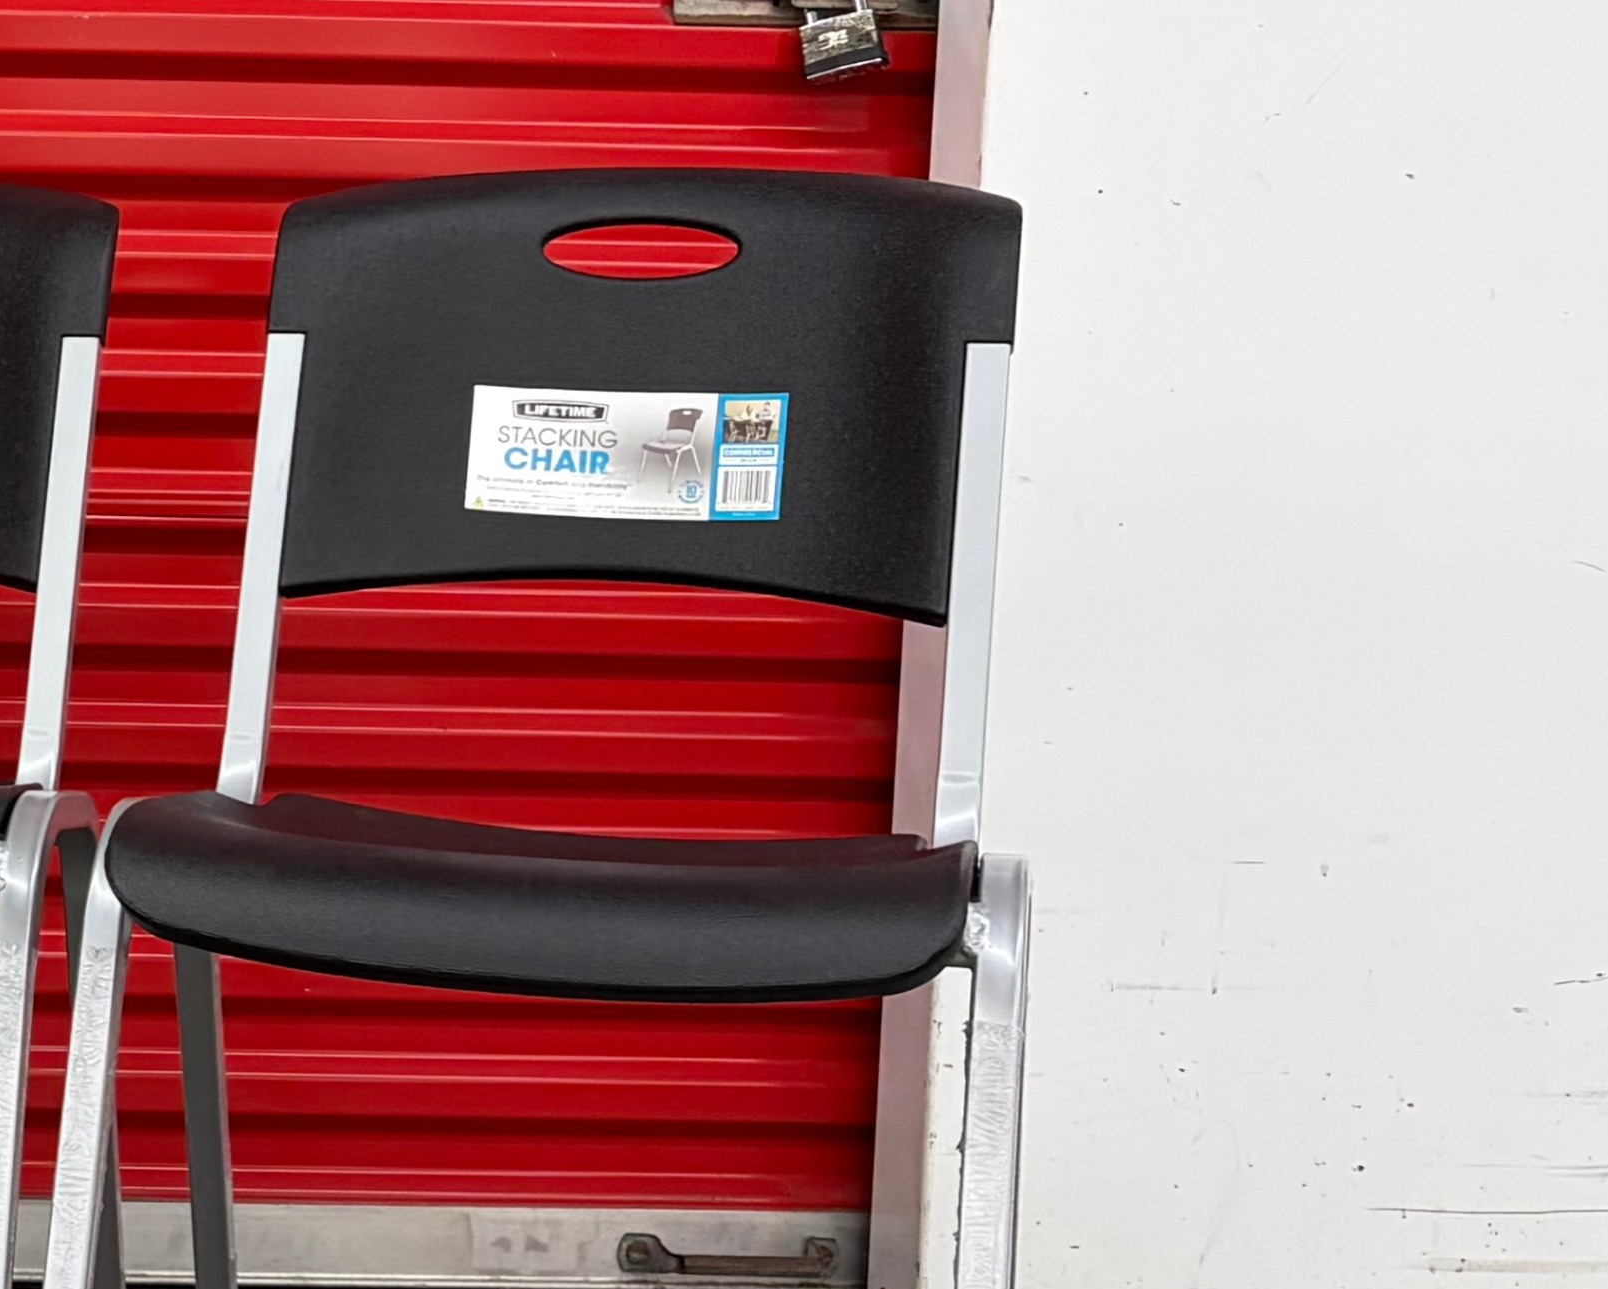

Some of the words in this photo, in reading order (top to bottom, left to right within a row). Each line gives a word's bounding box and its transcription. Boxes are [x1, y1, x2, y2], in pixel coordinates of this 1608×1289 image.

[524, 404, 596, 418] LIFETIME
[497, 425, 618, 449] STACKING
[503, 446, 610, 475] CHAIR
